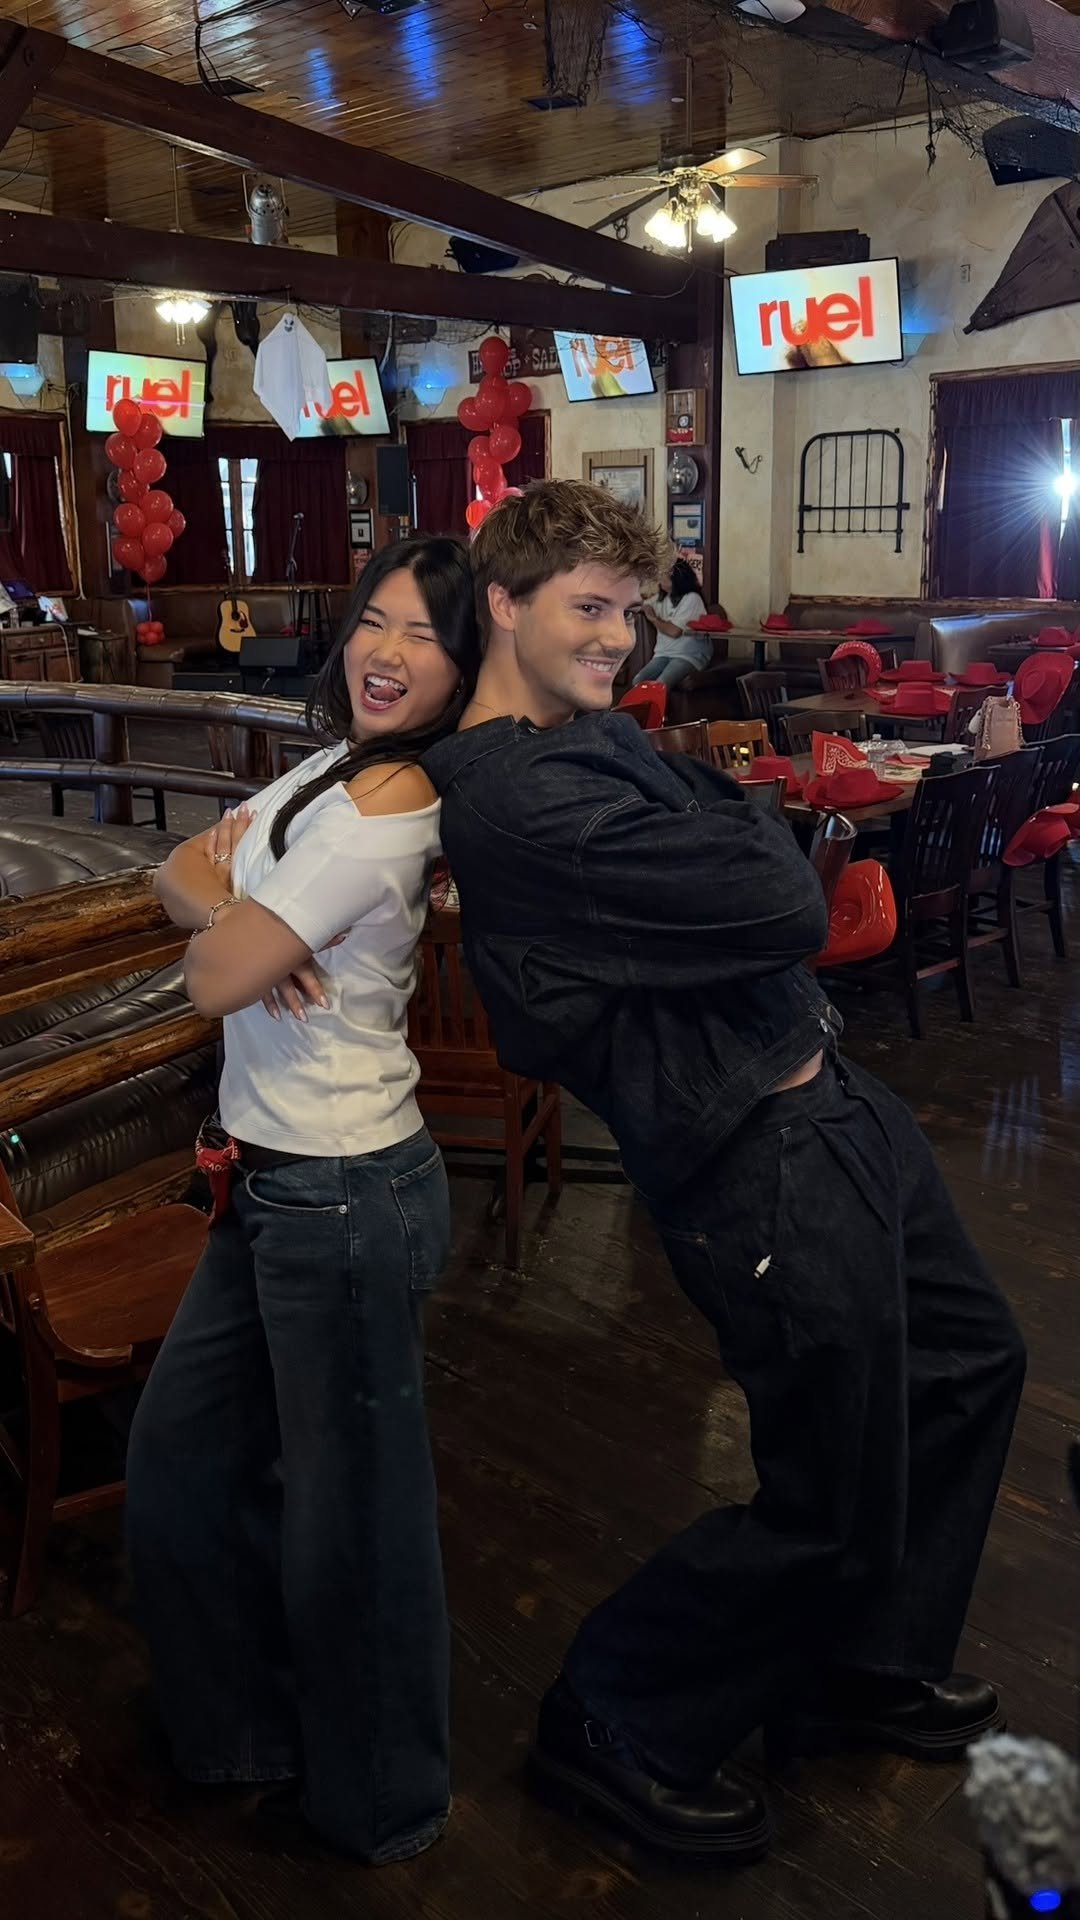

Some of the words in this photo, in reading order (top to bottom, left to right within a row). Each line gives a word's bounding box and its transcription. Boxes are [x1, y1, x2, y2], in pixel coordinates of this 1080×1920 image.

[759, 276, 874, 346] ruel
[105, 369, 191, 419] ruel
[303, 370, 371, 421] uel
